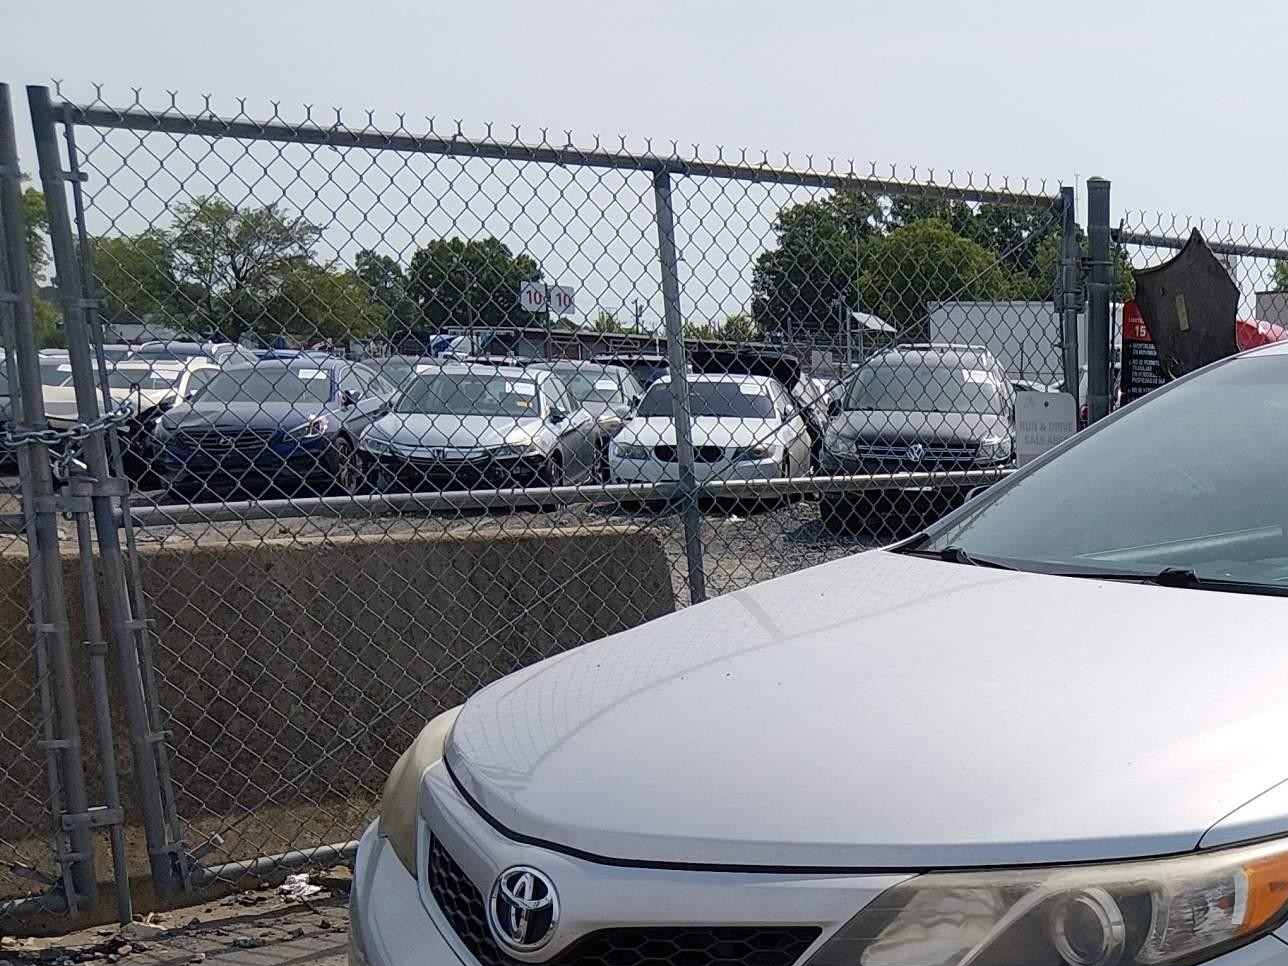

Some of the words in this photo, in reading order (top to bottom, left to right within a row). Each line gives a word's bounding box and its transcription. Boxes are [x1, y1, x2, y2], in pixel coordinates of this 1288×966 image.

[526, 290, 542, 305] 10
[556, 292, 571, 307] 10
[1134, 325, 1147, 337] 15
[1019, 421, 1037, 432] RUN
[1040, 422, 1047, 432] &
[1049, 422, 1074, 433] DRIVE
[1024, 434, 1046, 446] SALE
